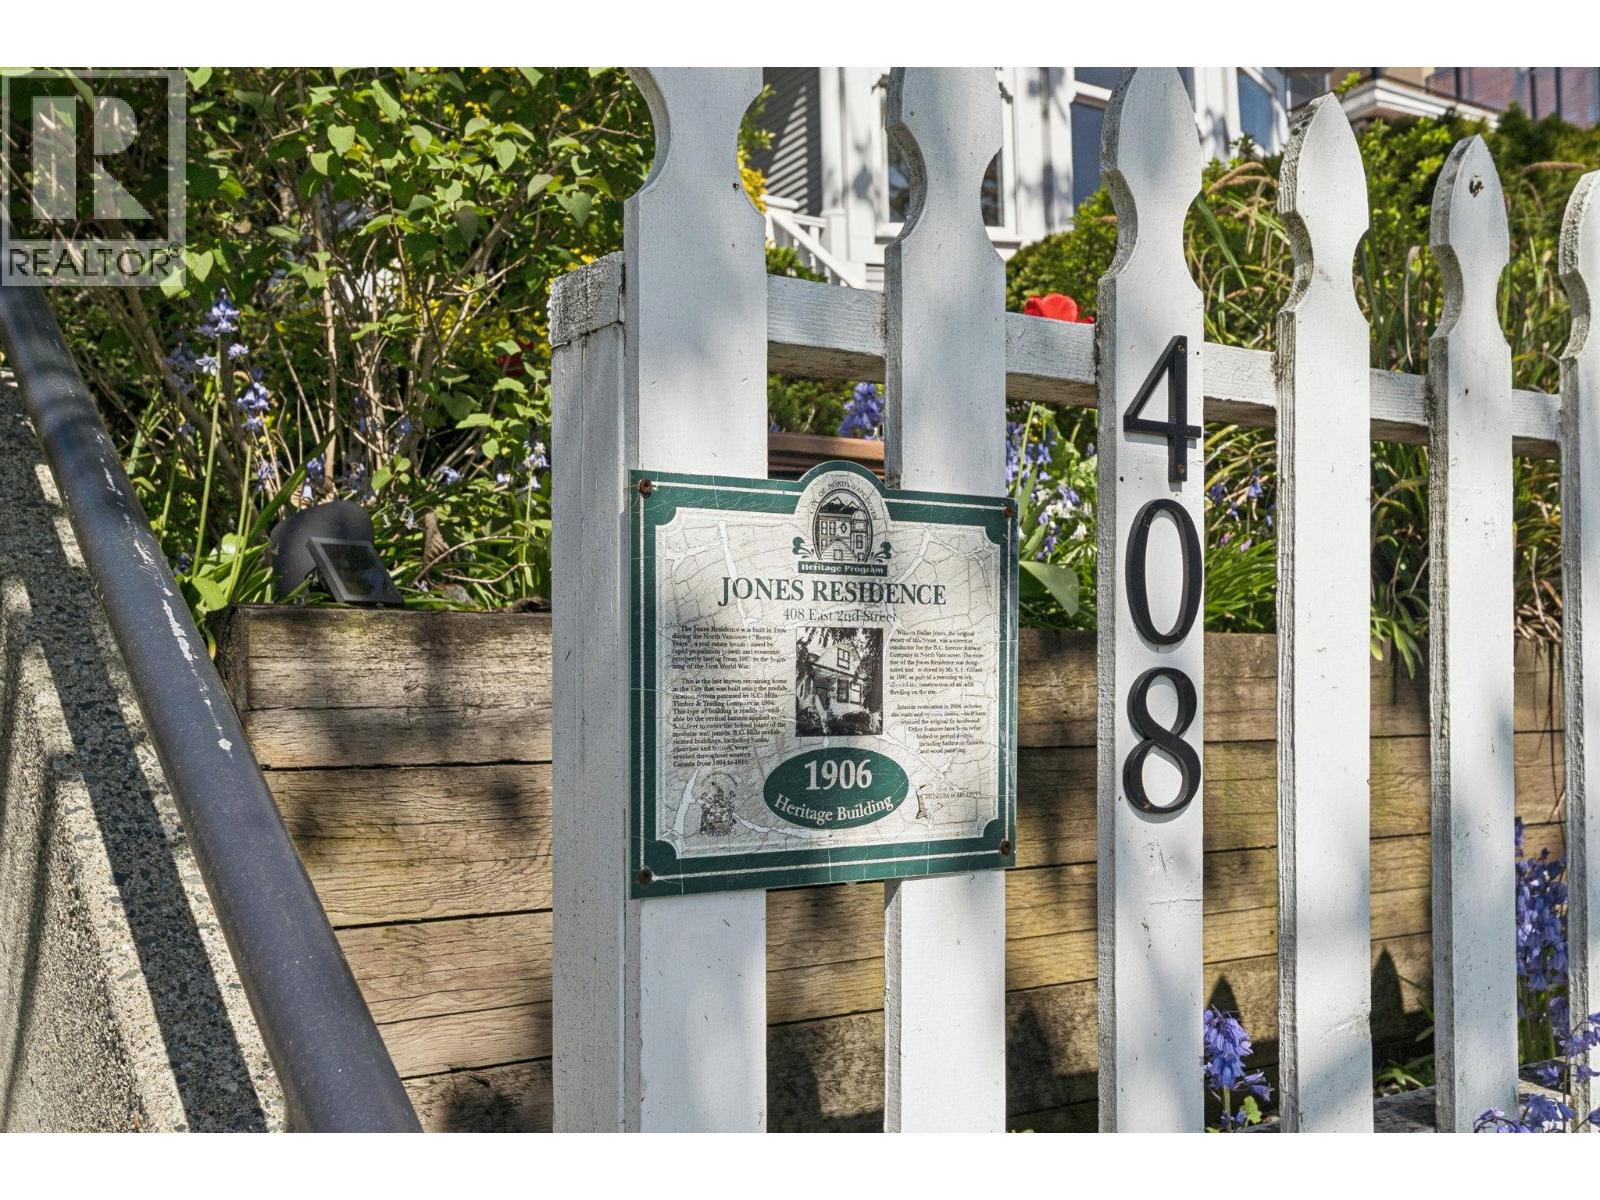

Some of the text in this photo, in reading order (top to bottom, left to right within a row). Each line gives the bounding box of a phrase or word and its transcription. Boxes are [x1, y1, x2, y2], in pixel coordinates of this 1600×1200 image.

[801, 563, 884, 574] Heritage Program
[718, 577, 946, 606] JONES RESIDENCE
[783, 608, 896, 622] 408 East 2nd Street
[804, 759, 873, 791] 1906
[774, 793, 894, 825] Heritage Building
